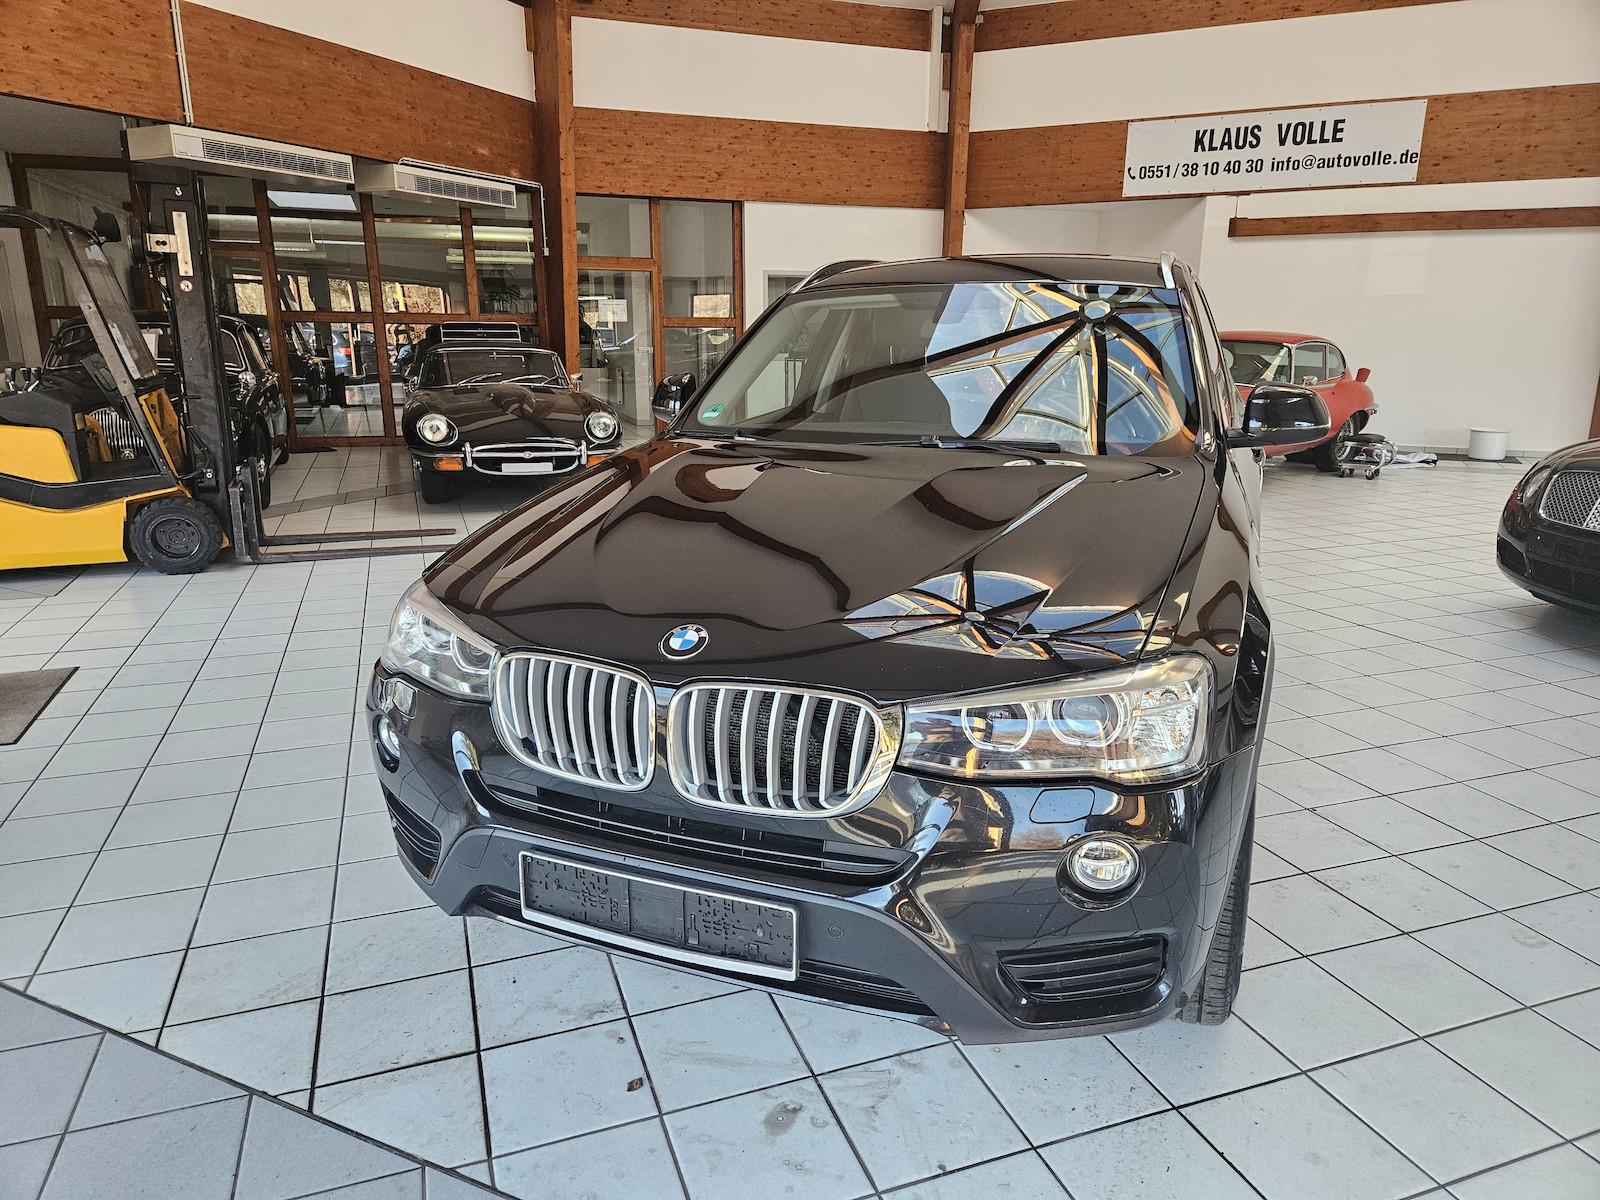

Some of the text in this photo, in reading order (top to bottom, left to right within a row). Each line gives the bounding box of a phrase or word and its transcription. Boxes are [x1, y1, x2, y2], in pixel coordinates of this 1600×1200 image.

[1194, 118, 1346, 153] KLAUS VOLLE
[1202, 161, 1220, 176] 10
[1223, 160, 1241, 175] 40
[1245, 158, 1264, 173] 30
[1270, 149, 1419, 172] info@autovolle.de
